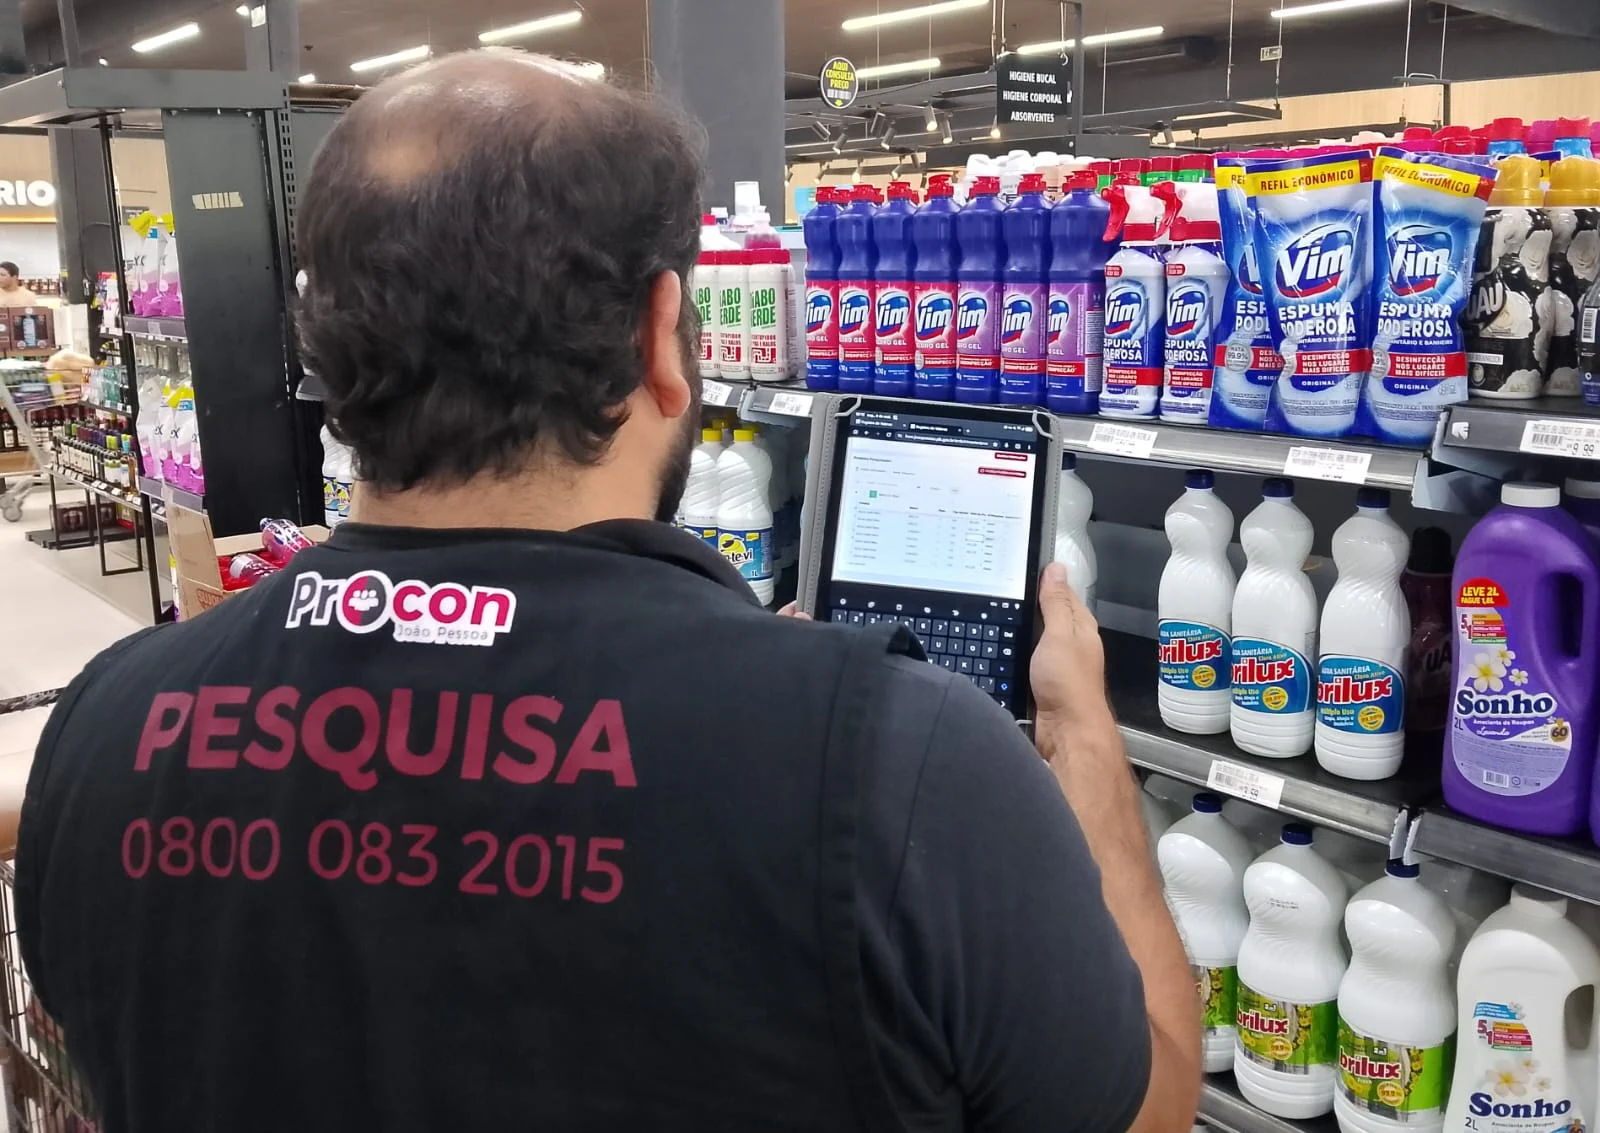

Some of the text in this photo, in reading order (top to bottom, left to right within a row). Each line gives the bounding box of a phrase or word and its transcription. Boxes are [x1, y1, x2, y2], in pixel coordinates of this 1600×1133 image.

[826, 69, 854, 81] CONSULTA
[1009, 71, 1056, 84] HIGIENE BUCAL
[1003, 90, 1062, 104] HIGIENE CORPORAL
[1010, 110, 1054, 122] ABSORVENTES
[1261, 169, 1354, 191] REFIL ECONÔMICO
[1383, 165, 1407, 179] REFIL
[1278, 244, 1353, 287] Vim
[1391, 242, 1450, 283] Vim
[1106, 299, 1140, 326] Vim
[1167, 299, 1204, 327] Vim
[1278, 302, 1355, 321] ESPUMA
[1380, 301, 1453, 319] ESPUMA
[916, 306, 952, 333] Vim
[1377, 318, 1453, 338] PODEROSA
[1302, 352, 1350, 361] DESINFECÇÃO
[1396, 356, 1446, 364] DESINFECÇÃO
[1463, 586, 1500, 596] LEVE 2L
[397, 624, 489, 641] João Pessoa
[1232, 657, 1294, 684] rilux
[1334, 665, 1370, 675] SANITÁRIA
[1456, 690, 1553, 716] Sonho
[134, 685, 638, 791] PESQUISA
[1551, 727, 1568, 738] 60
[121, 816, 625, 903] 0800 083 2015
[1478, 1020, 1487, 1034] 5
[1340, 1046, 1401, 1079] brilux
[1469, 1092, 1572, 1118] Sonho
[1465, 1116, 1479, 1131] 2L
